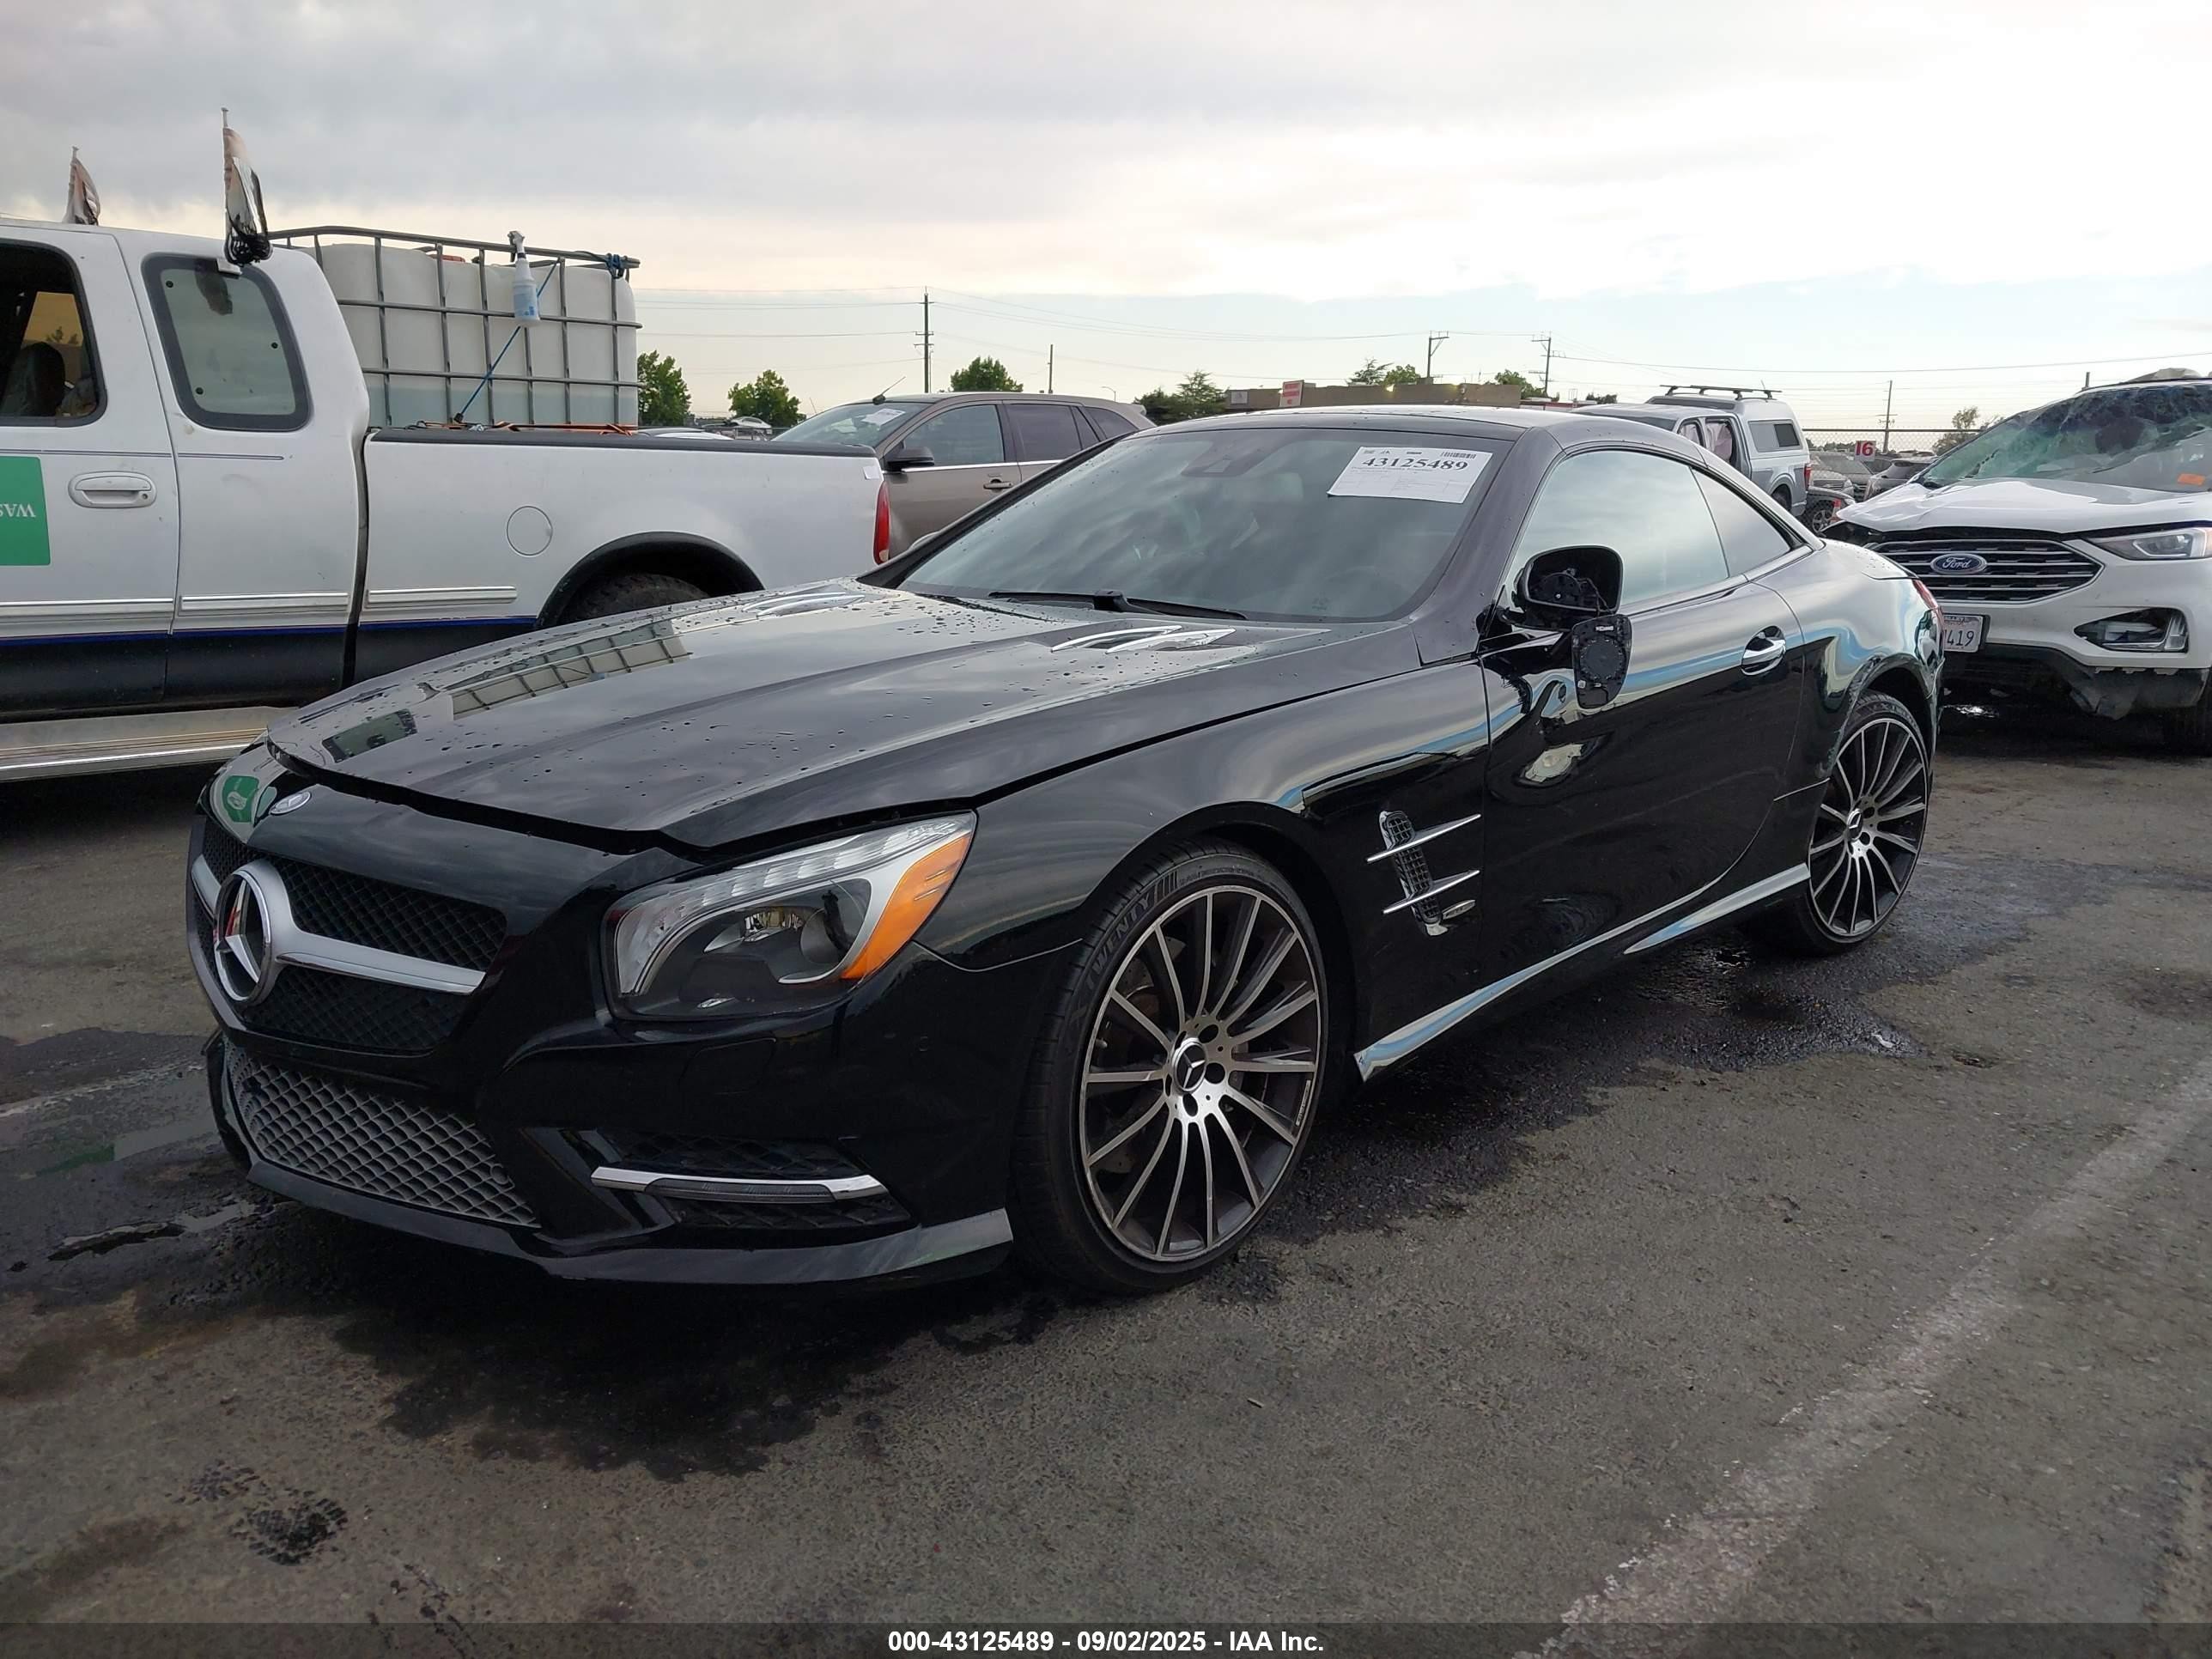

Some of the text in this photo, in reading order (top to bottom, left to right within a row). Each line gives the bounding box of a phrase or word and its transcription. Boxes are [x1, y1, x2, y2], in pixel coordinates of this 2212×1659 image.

[1856, 440, 1873, 456] 16
[1362, 457, 1468, 470] 43125489
[1942, 556, 1972, 568] Ford
[1944, 629, 1974, 647] 419
